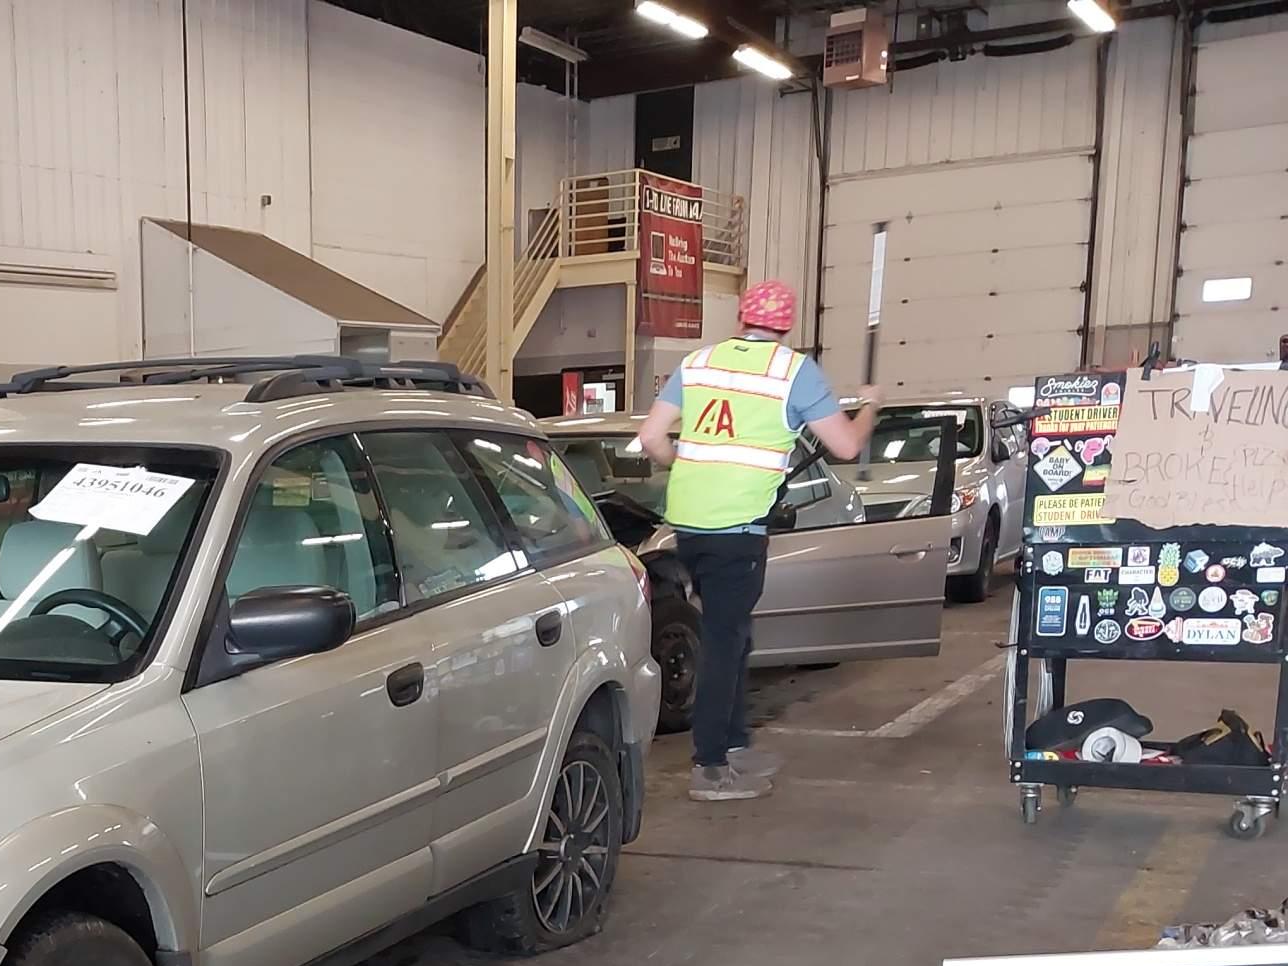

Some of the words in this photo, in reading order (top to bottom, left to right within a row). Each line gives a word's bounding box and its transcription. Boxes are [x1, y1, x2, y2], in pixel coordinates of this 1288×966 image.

[1087, 407, 1118, 419] DRIVER
[1123, 451, 1228, 486] BROKE
[72, 476, 168, 498] 43951046
[1039, 499, 1067, 509] PLEASE
[1068, 498, 1080, 508] BE
[1038, 511, 1075, 521] STUDENT
[1086, 569, 1112, 581] FAT
[1187, 629, 1236, 640] DYLAN
